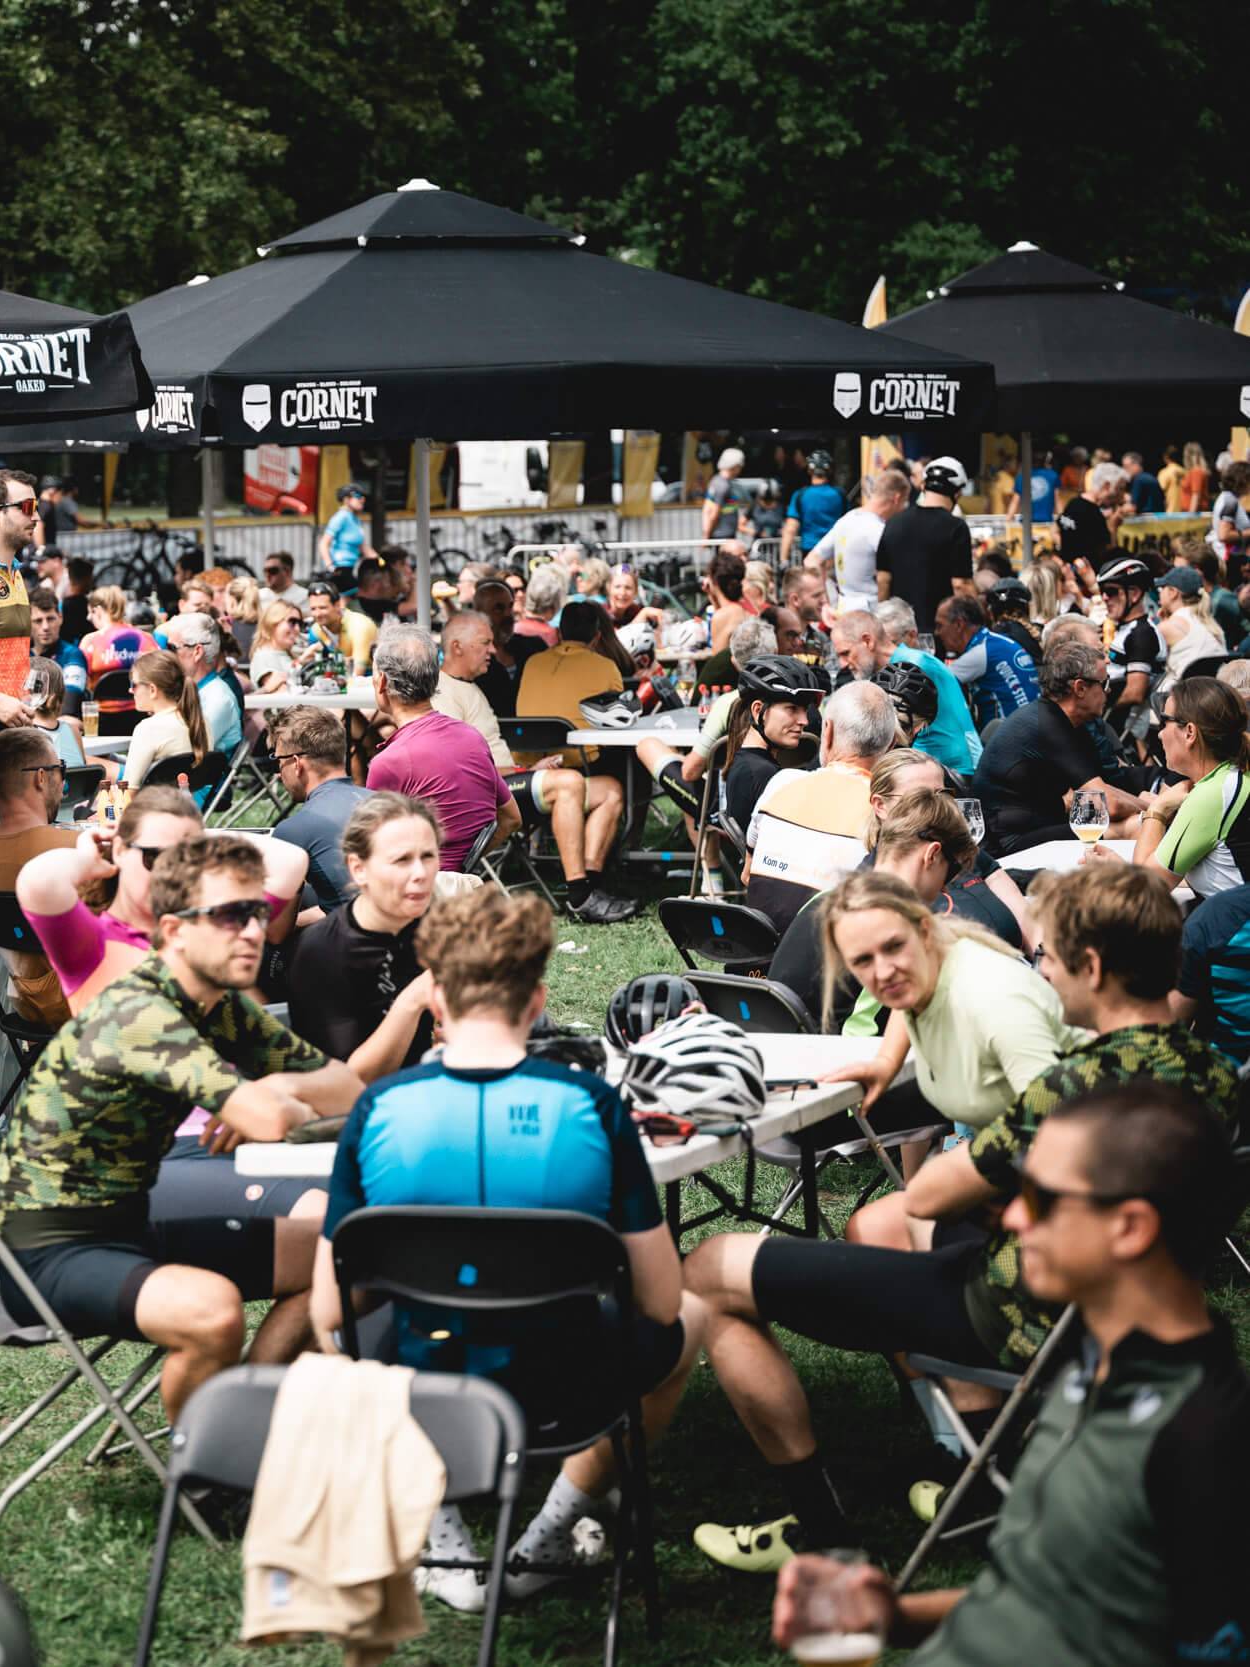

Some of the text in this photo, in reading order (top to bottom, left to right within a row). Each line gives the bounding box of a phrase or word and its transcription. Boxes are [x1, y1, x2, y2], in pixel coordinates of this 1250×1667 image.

[15, 379, 46, 393] OAKED
[870, 379, 960, 416] CORNET
[151, 391, 196, 429] CORNET
[280, 386, 377, 428] CORNET
[761, 855, 789, 872] Kom op
